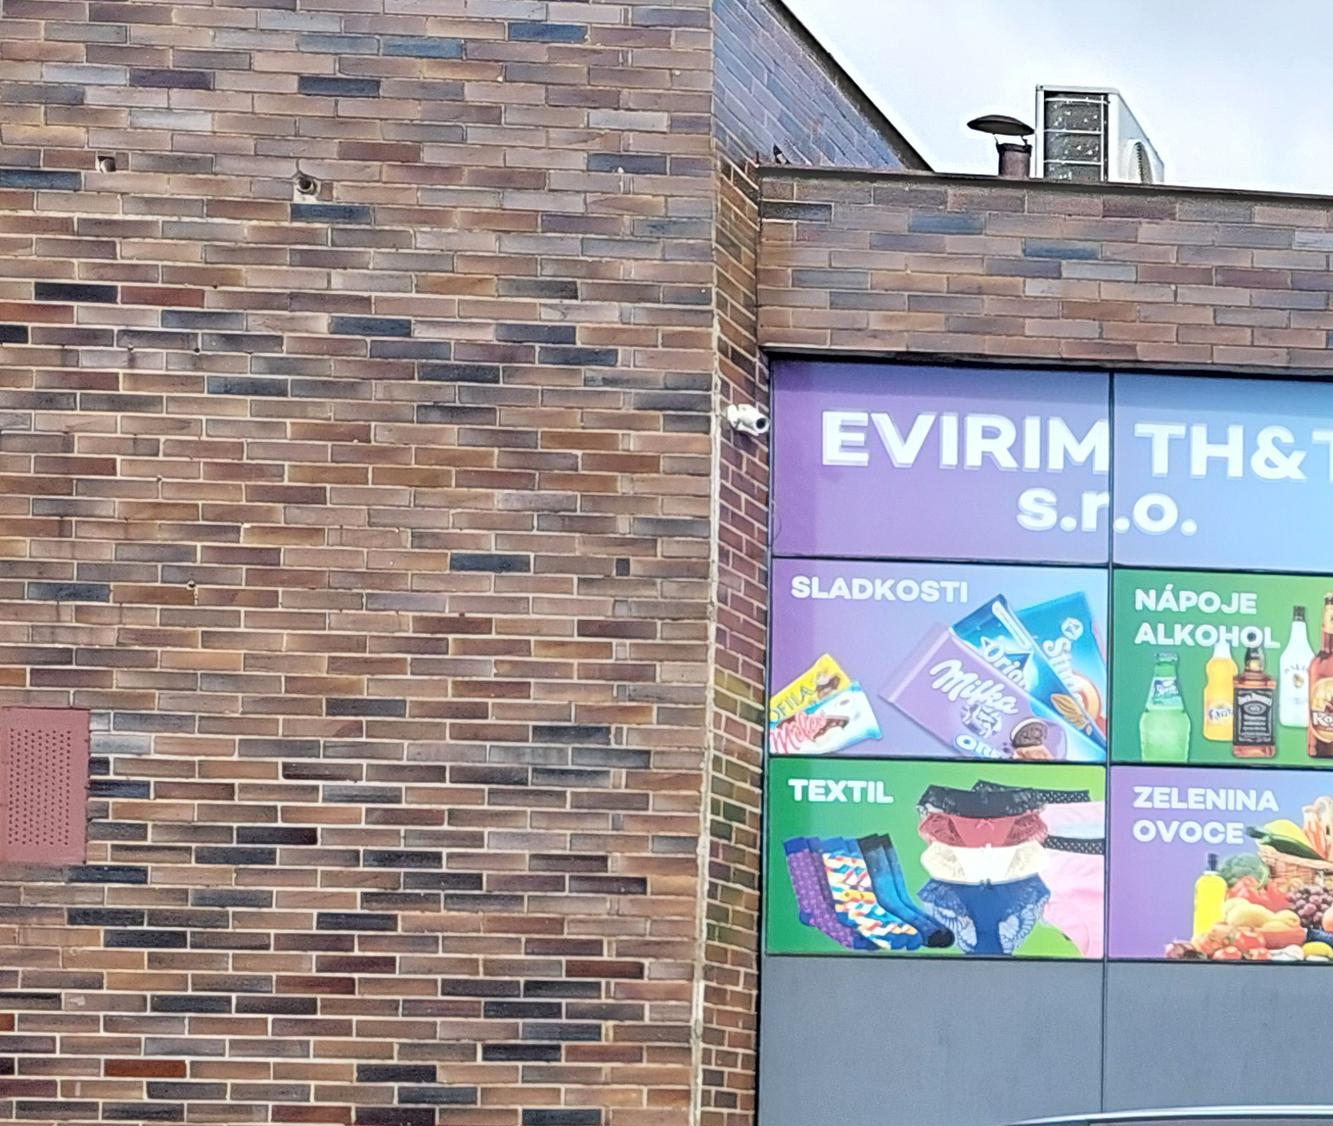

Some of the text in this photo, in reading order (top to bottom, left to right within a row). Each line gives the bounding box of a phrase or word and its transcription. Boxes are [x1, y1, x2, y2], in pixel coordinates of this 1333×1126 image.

[821, 410, 1110, 475] EVIRIM
[1015, 487, 1197, 536] s.r.o.
[791, 576, 969, 604] SLADKOSTI
[1135, 584, 1257, 614] NÁPOJE
[1134, 622, 1280, 649] ALKOHOL
[929, 659, 1020, 715] Milka
[769, 685, 816, 722] OFILA
[788, 778, 893, 803] TEXTIL
[1132, 786, 1279, 812] ZELENINA
[1132, 818, 1244, 846] OVOCE
